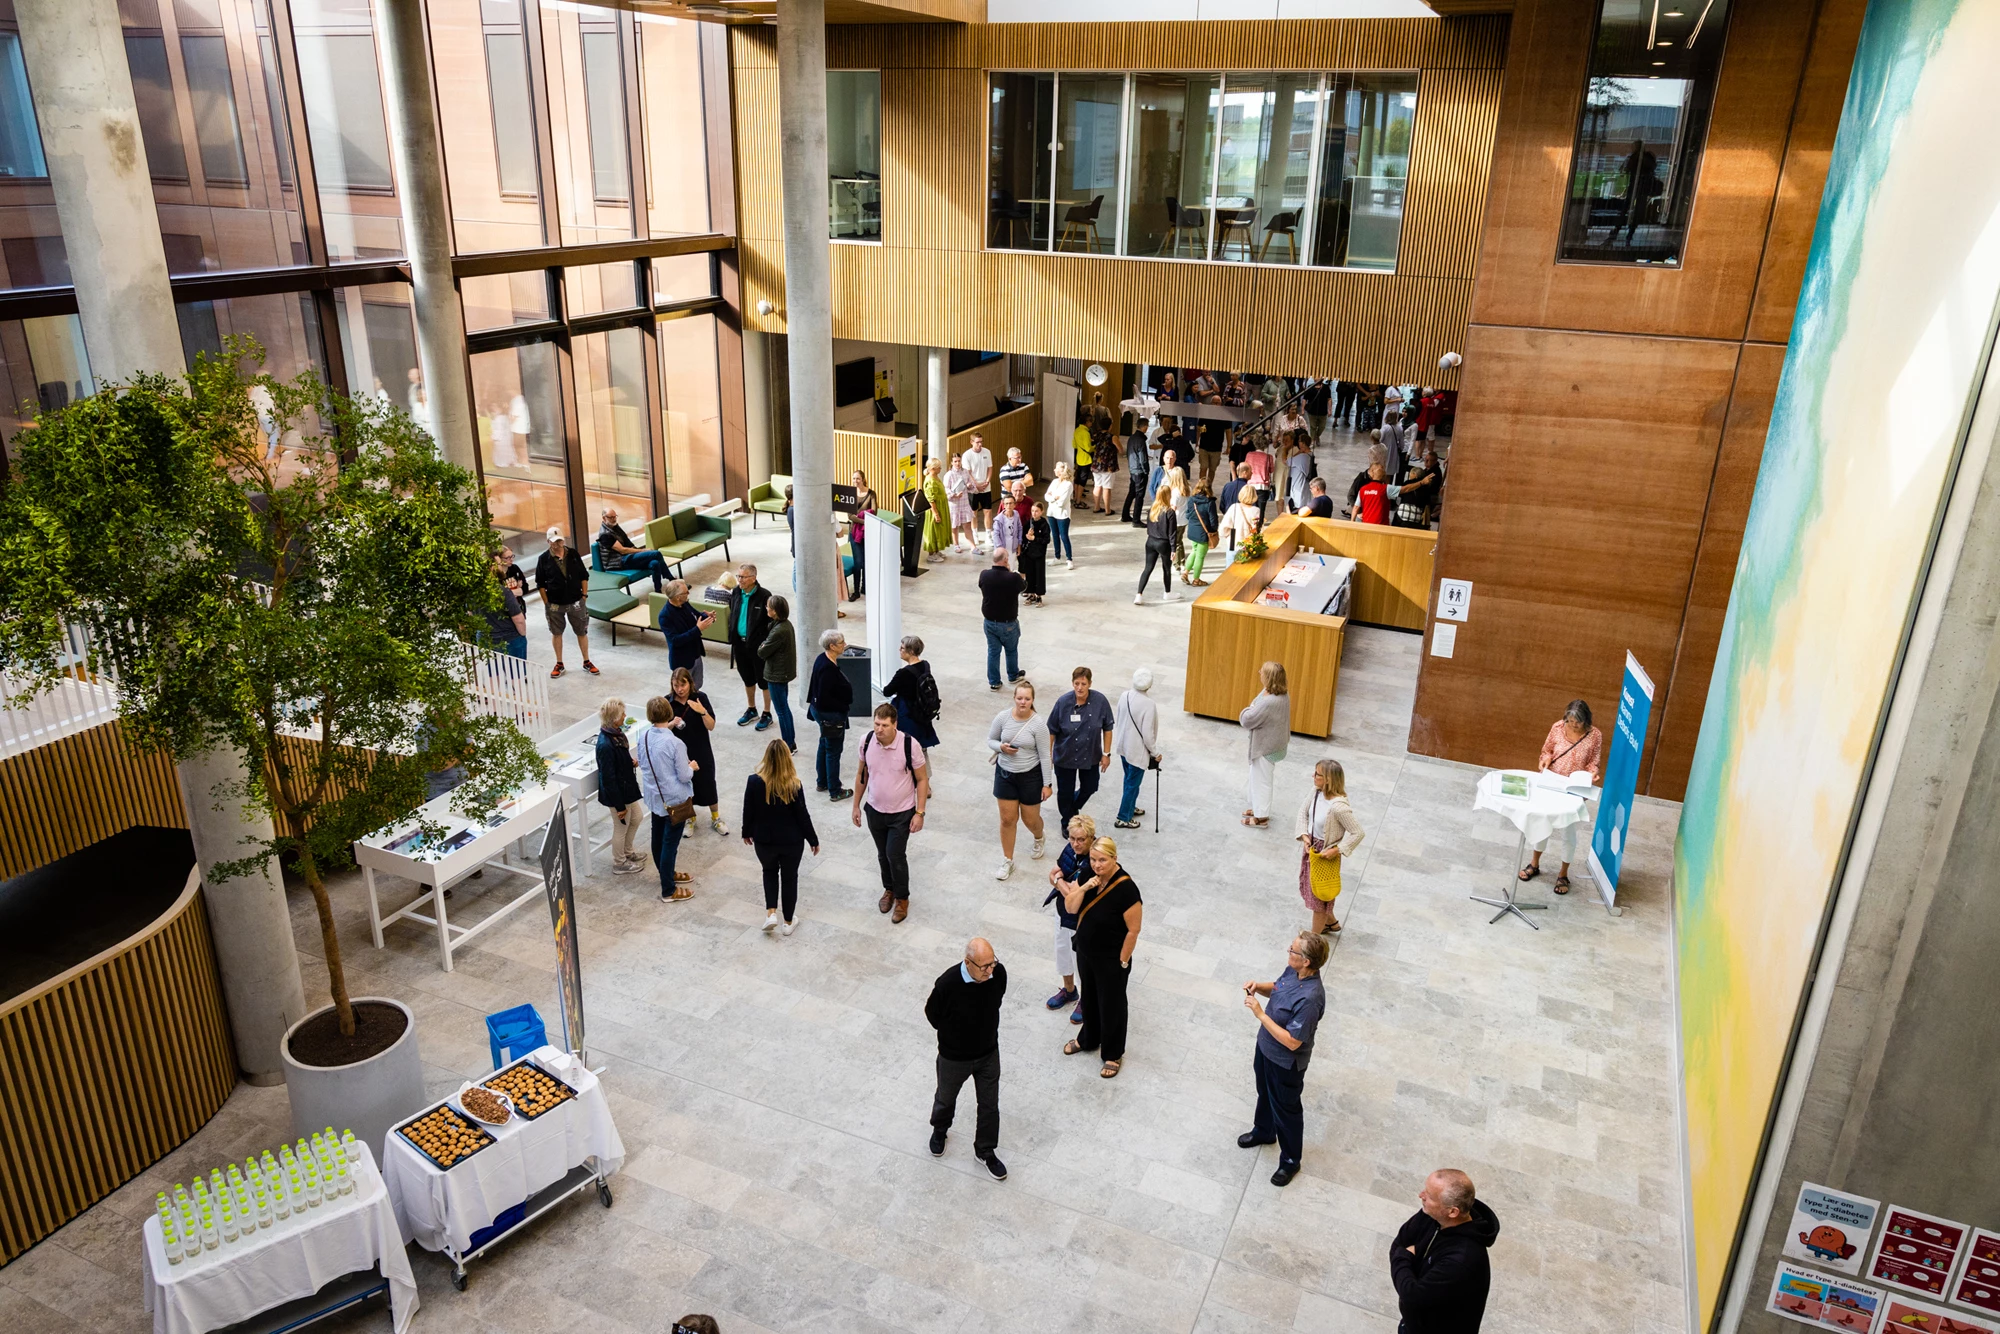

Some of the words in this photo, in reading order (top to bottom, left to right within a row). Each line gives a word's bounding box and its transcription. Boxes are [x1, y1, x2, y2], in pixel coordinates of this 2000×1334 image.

[833, 493, 855, 505] A210
[1804, 1198, 1823, 1207] type
[1825, 1204, 1869, 1220] 1-diabetes
[1822, 1196, 1839, 1205] Lær
[1810, 1208, 1828, 1217] med
[1830, 1212, 1859, 1225] Sten-O
[1786, 1267, 1804, 1276] Hvad
[1815, 1275, 1832, 1284] type
[1833, 1280, 1877, 1296] 1-diabetes?
